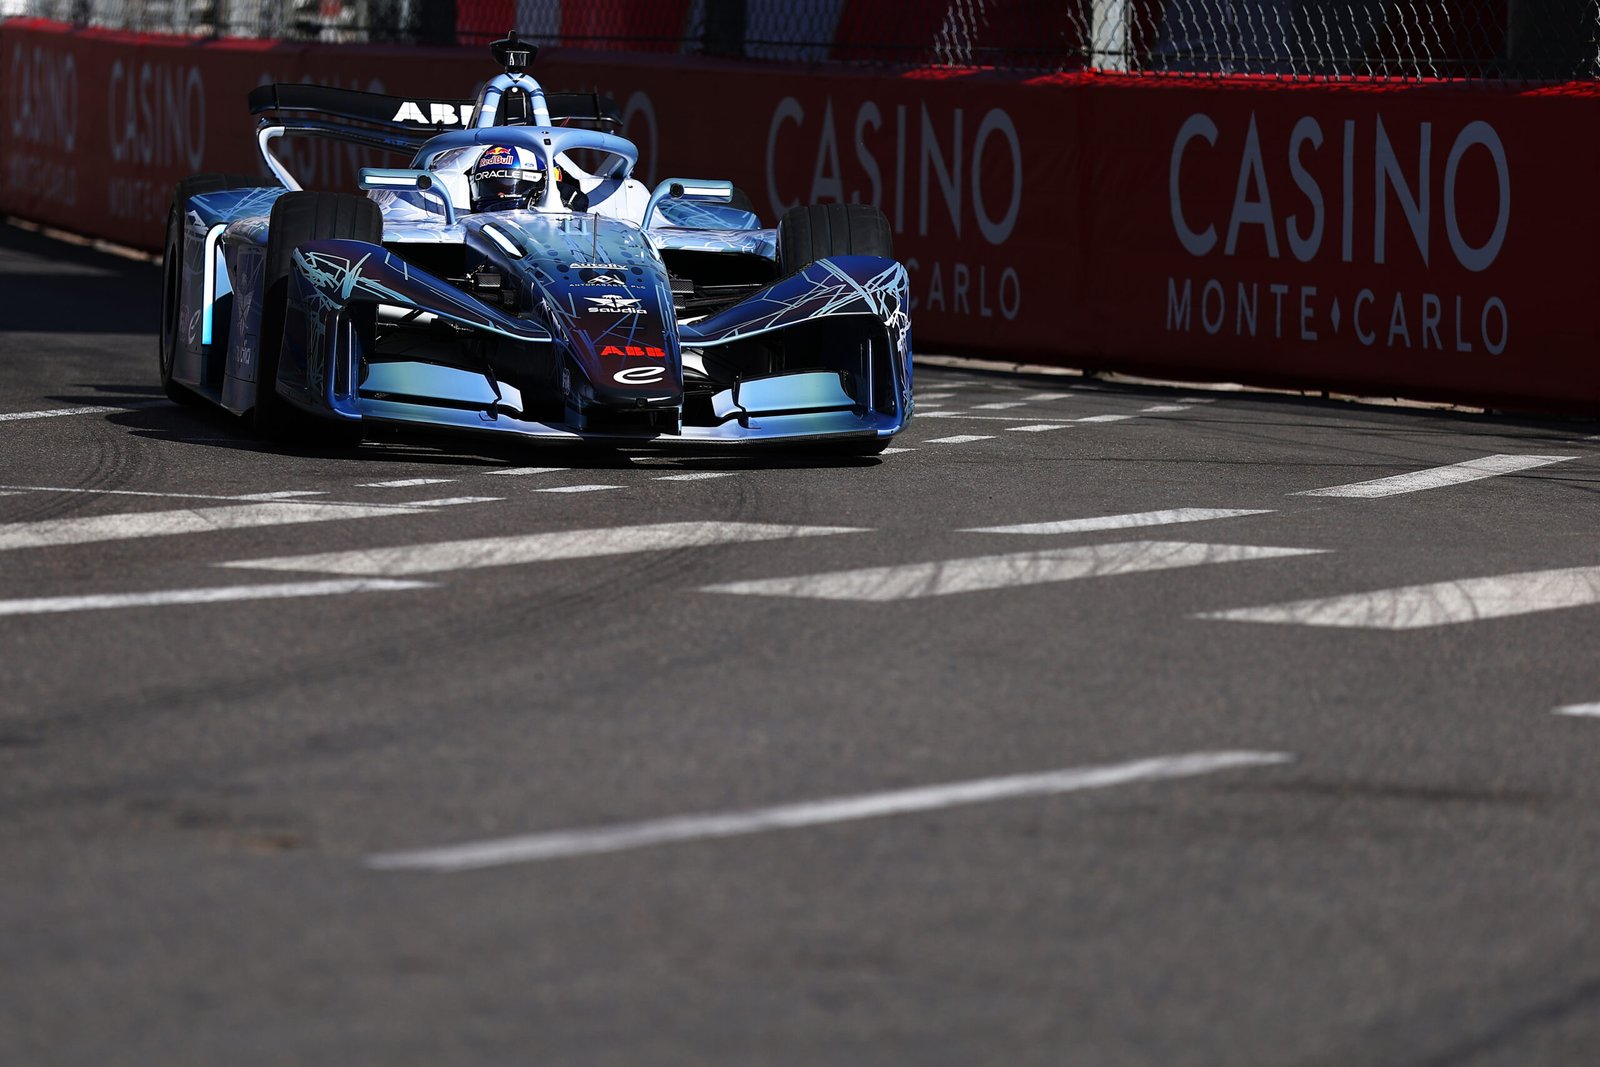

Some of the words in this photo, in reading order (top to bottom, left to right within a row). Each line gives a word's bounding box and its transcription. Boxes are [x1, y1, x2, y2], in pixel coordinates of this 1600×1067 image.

[108, 59, 207, 171] CASINO
[475, 170, 521, 180] ORACLE
[479, 157, 495, 167] Red
[495, 155, 514, 164] Bull
[766, 95, 1023, 245] CASINO
[1169, 110, 1511, 272] CASINO
[601, 345, 666, 358] ABB
[1167, 277, 1318, 341] MONTE
[1353, 288, 1508, 355] CARLO
